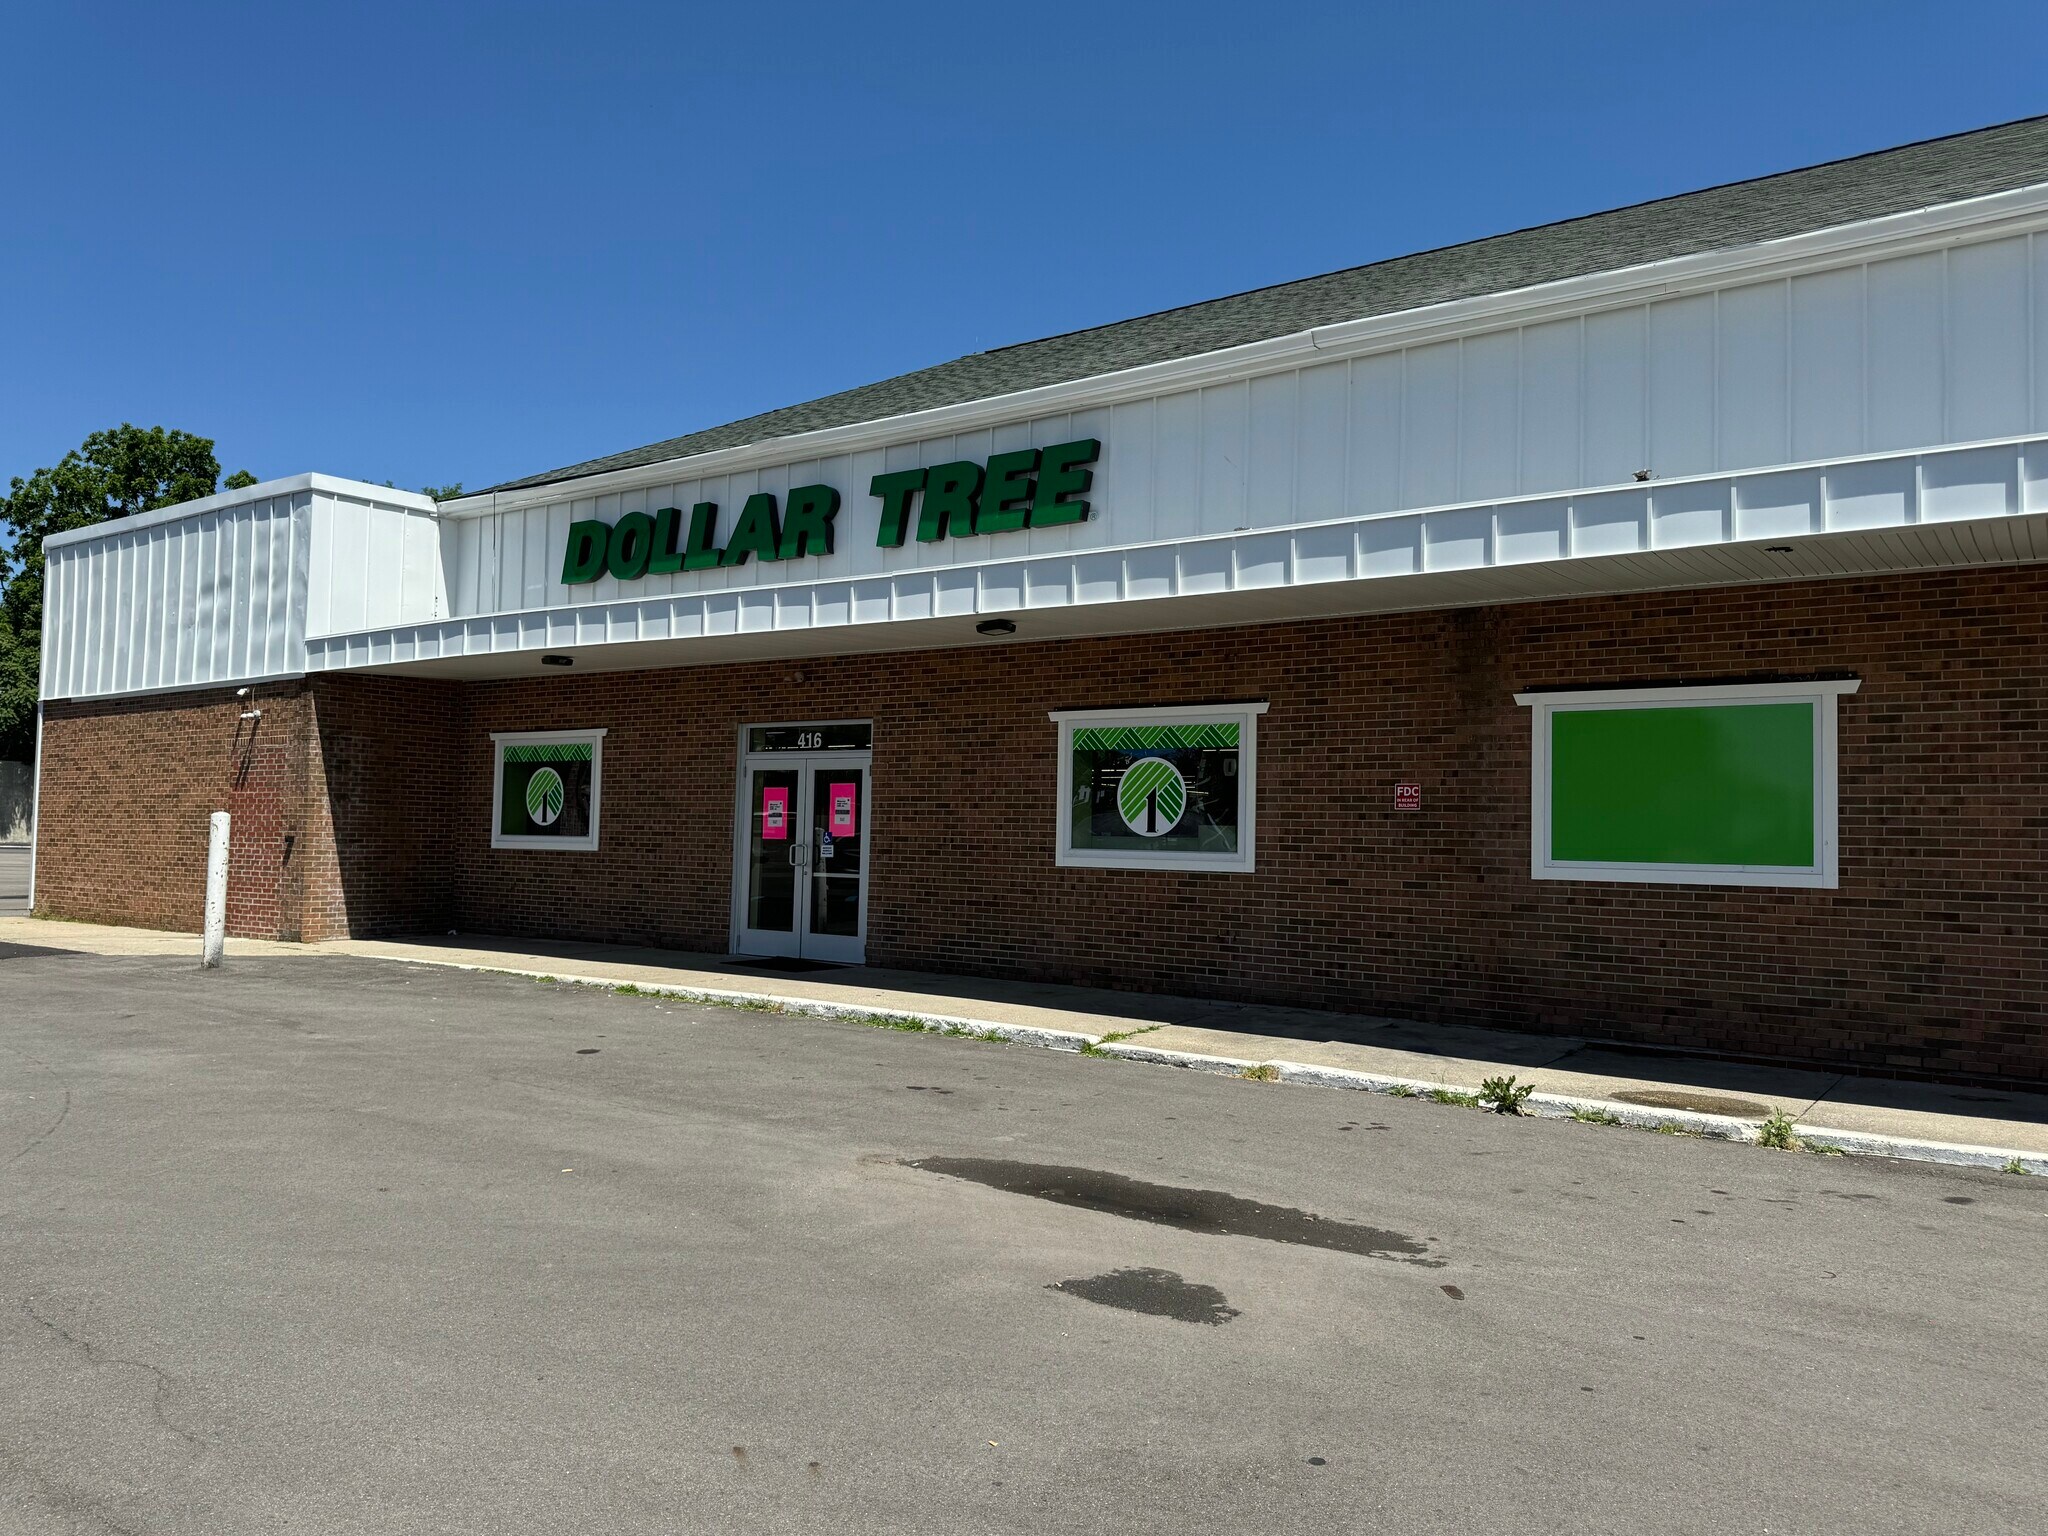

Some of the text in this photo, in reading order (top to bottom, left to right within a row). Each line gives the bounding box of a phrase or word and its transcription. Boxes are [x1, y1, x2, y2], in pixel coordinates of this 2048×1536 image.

[561, 438, 1101, 584] DOLLAR TREE
[798, 732, 822, 748] 416
[1397, 787, 1419, 796] FDC
